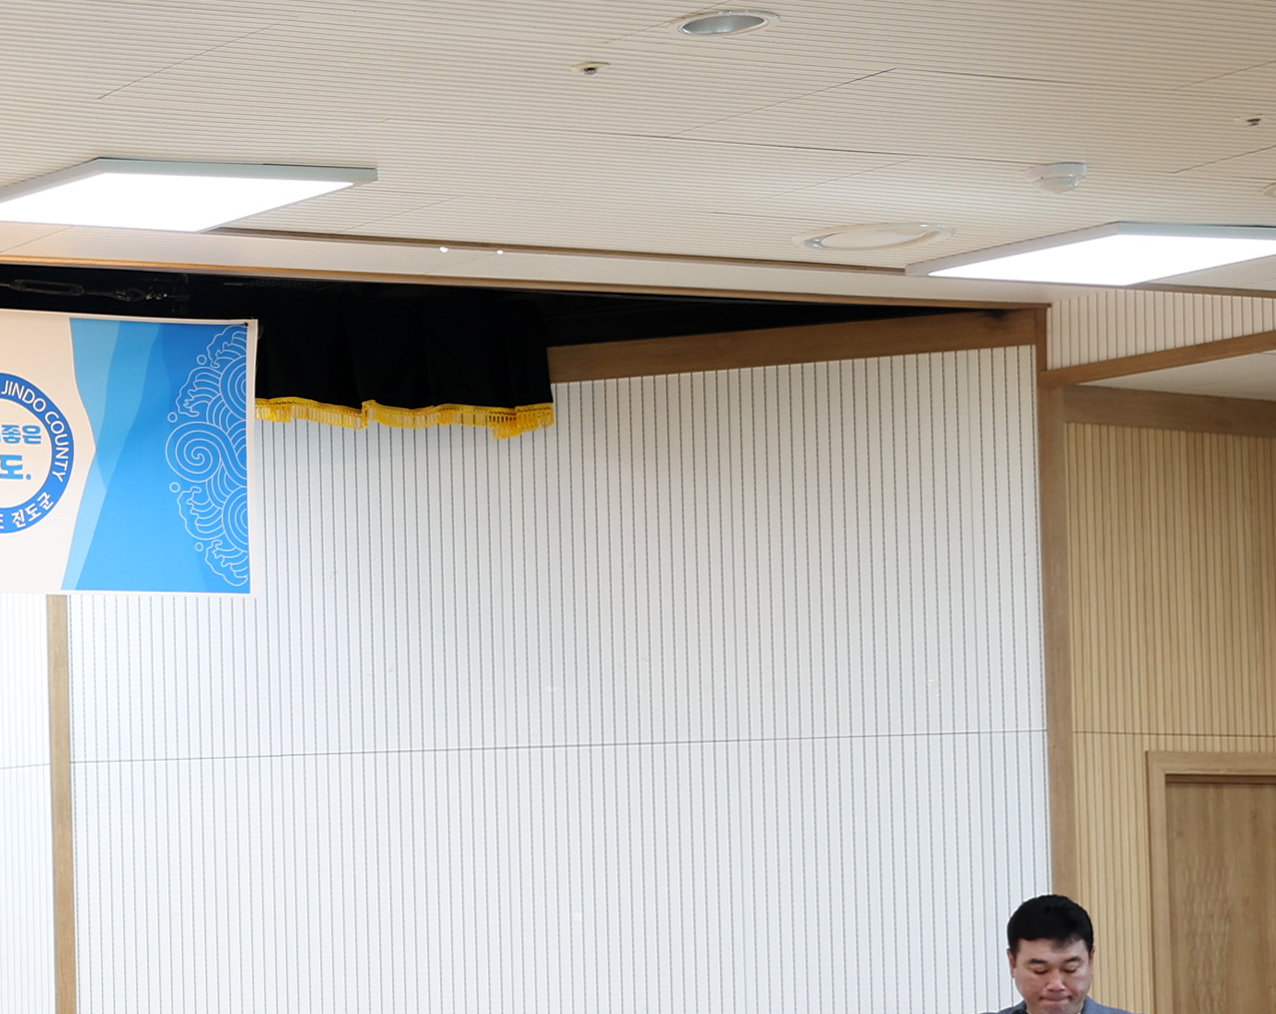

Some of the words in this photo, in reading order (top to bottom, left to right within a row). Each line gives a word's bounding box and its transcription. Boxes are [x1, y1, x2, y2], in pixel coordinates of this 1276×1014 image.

[1, 380, 47, 413] JINDO
[44, 411, 70, 483] COUNTY
[11, 491, 54, 529] 진도군
